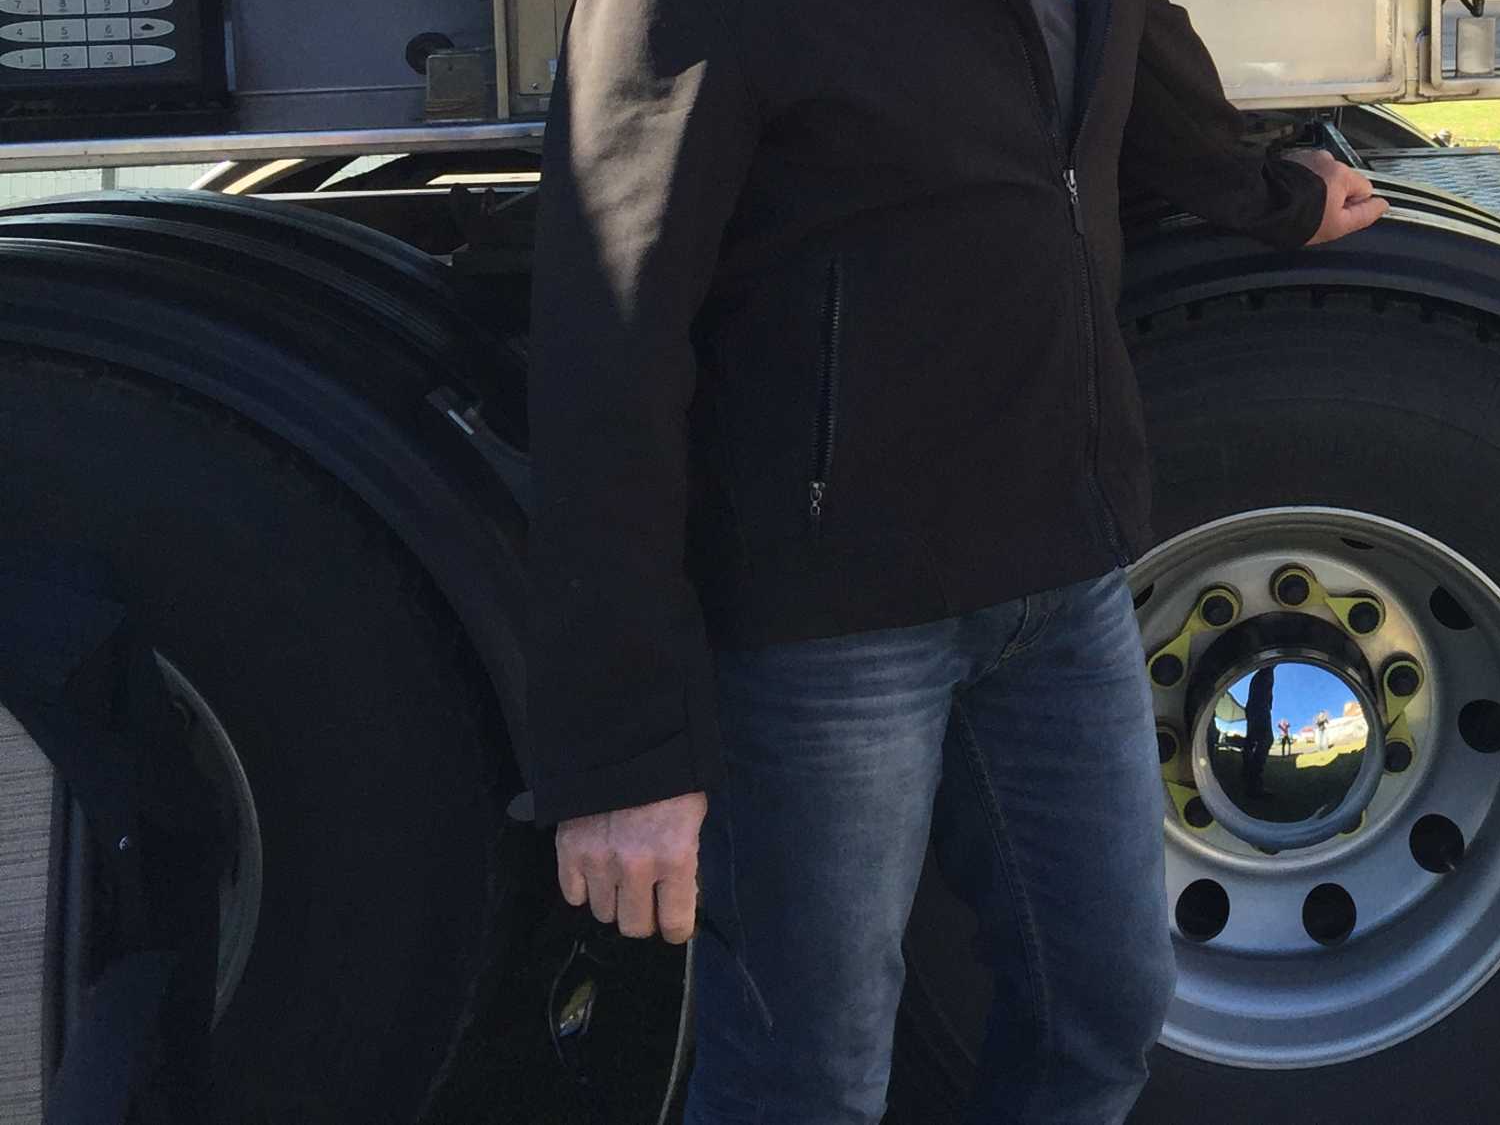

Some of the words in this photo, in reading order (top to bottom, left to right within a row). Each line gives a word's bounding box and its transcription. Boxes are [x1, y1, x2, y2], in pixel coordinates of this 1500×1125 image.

[14, 0, 22, 9] 7
[59, 0, 66, 8] 8
[16, 28, 23, 36] 4
[61, 27, 68, 36] 5
[105, 26, 112, 34] 6
[62, 54, 70, 63] 2
[107, 51, 114, 61] 3
